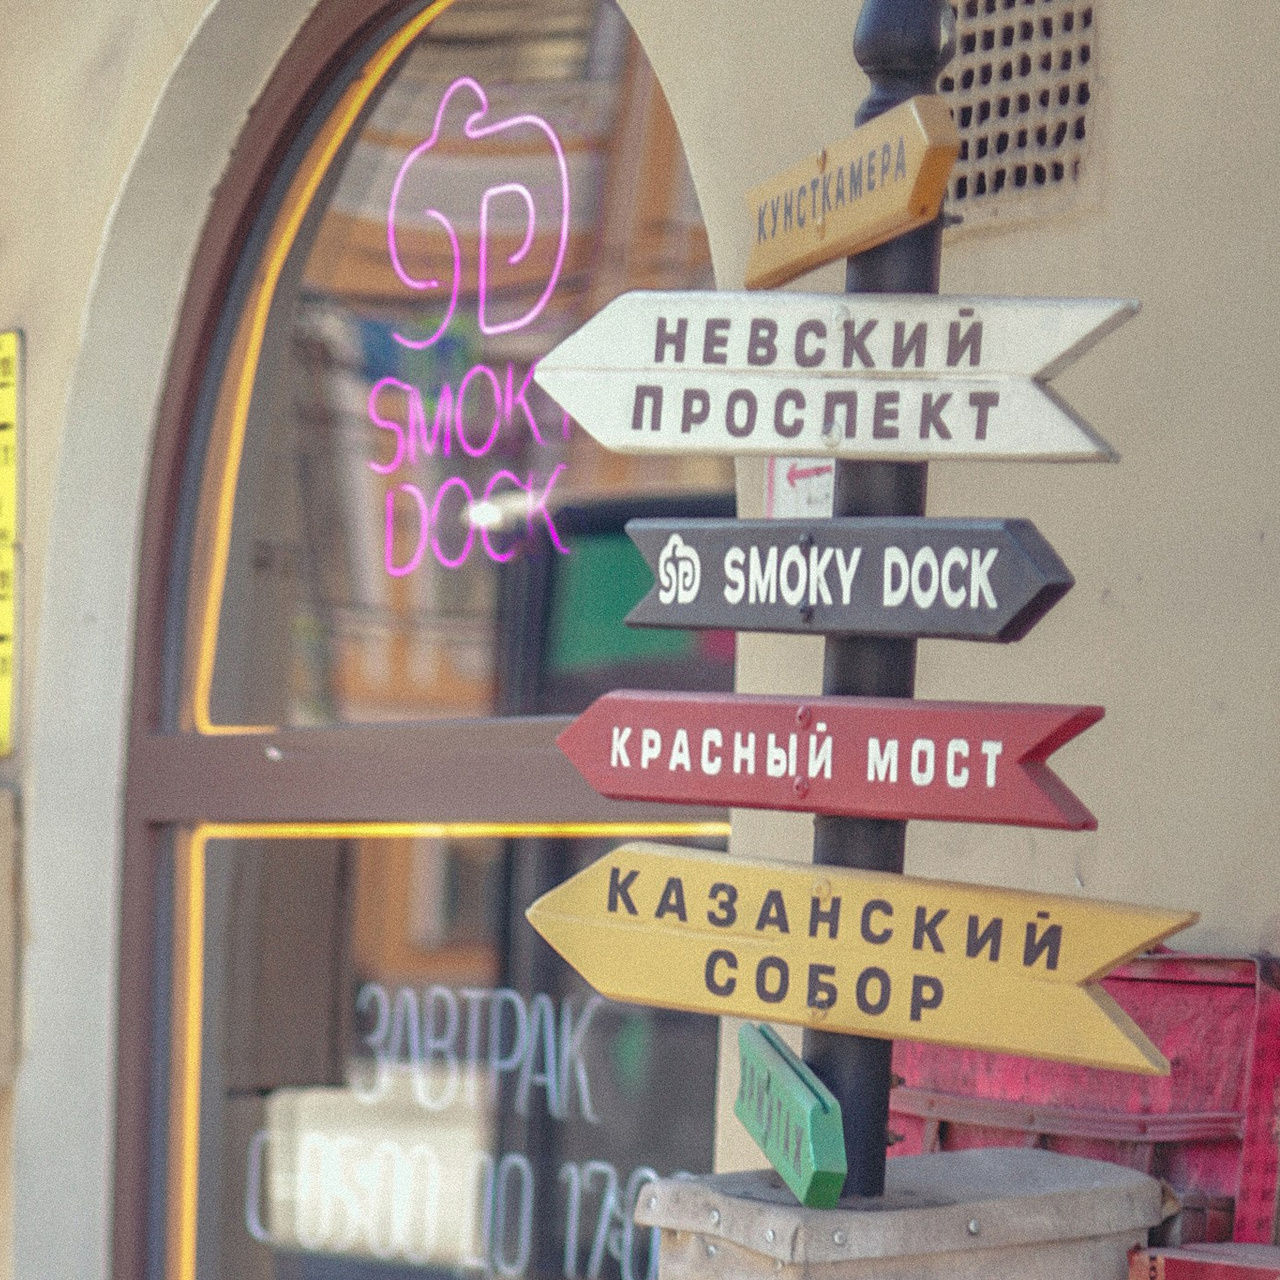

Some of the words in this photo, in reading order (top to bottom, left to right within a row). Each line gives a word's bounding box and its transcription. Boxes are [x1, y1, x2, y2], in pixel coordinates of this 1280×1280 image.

[756, 136, 907, 246] КУНСТКАМЕРА
[654, 308, 983, 368] НЕВСКИЙ
[368, 358, 571, 474] SMOK
[631, 384, 1000, 441] ПРОСПЕКТ
[386, 463, 570, 577] DOCK
[723, 544, 862, 606] SMOKY
[883, 545, 999, 609] DOCK
[610, 723, 833, 780] КРАСНЫЙ
[867, 736, 1004, 788] МОСТ
[606, 866, 1063, 971] КАЗАНСКИЙ
[704, 948, 945, 1022] СОБОР
[356, 983, 602, 1124] ЗАВТРАК
